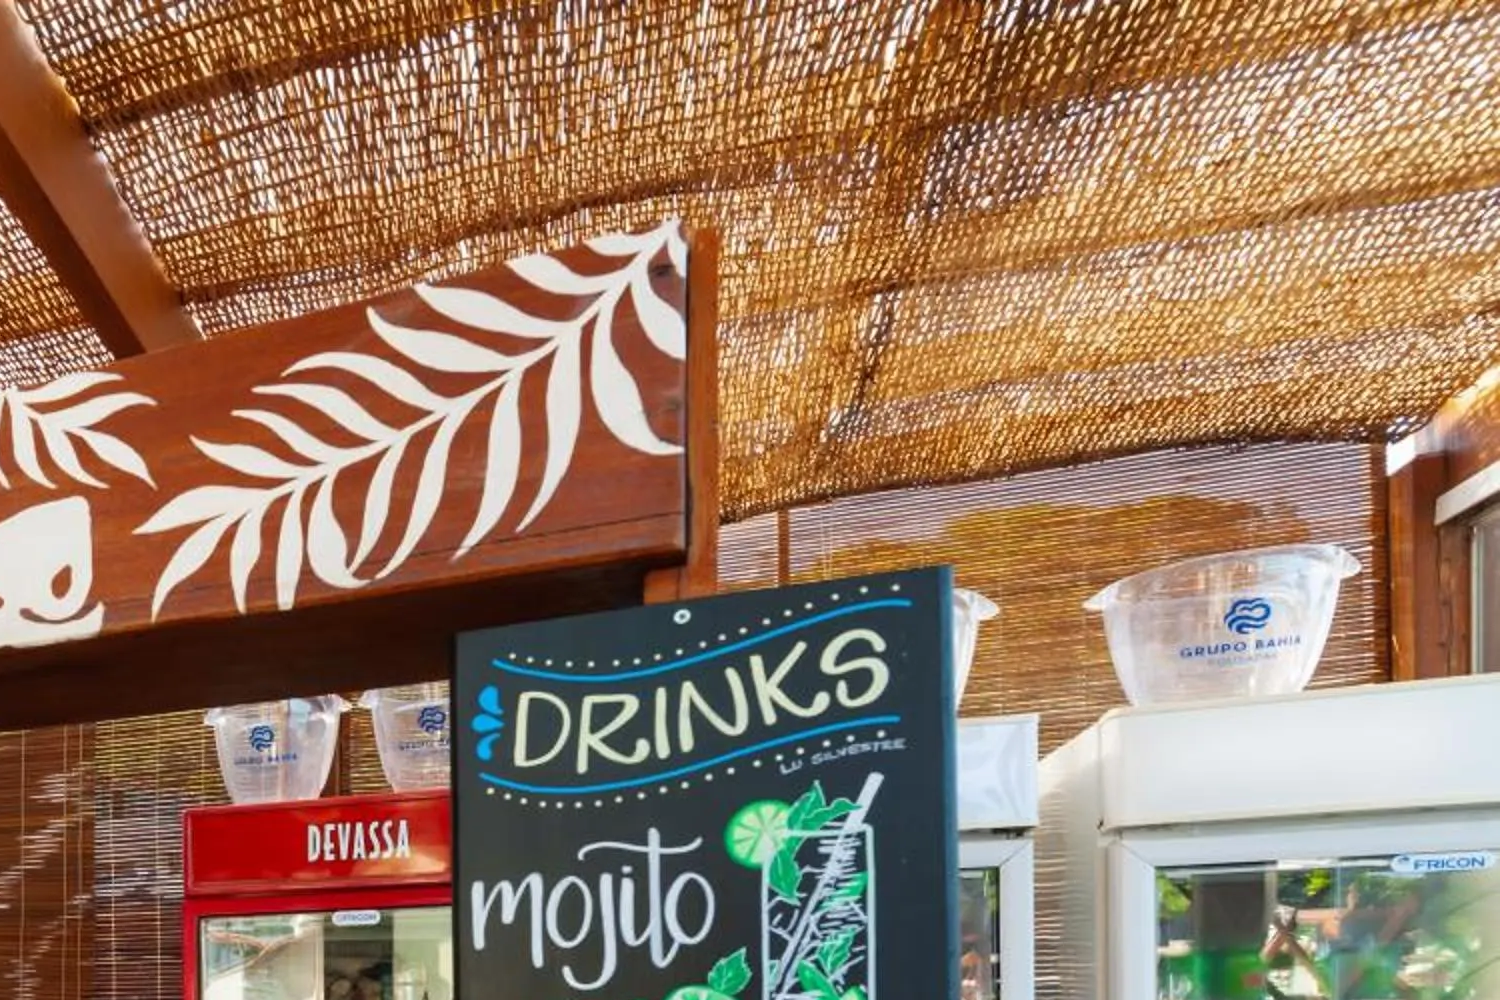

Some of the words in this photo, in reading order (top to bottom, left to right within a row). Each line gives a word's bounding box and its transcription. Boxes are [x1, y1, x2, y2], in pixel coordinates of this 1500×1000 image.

[1180, 641, 1247, 658] GRUPO
[1255, 634, 1301, 649] BAHIA
[513, 628, 890, 774] DRINKS
[811, 737, 907, 765] SILVESTRE
[307, 819, 411, 863] DEVASSA
[1413, 855, 1485, 870] FRICON
[471, 827, 715, 990] mojito
